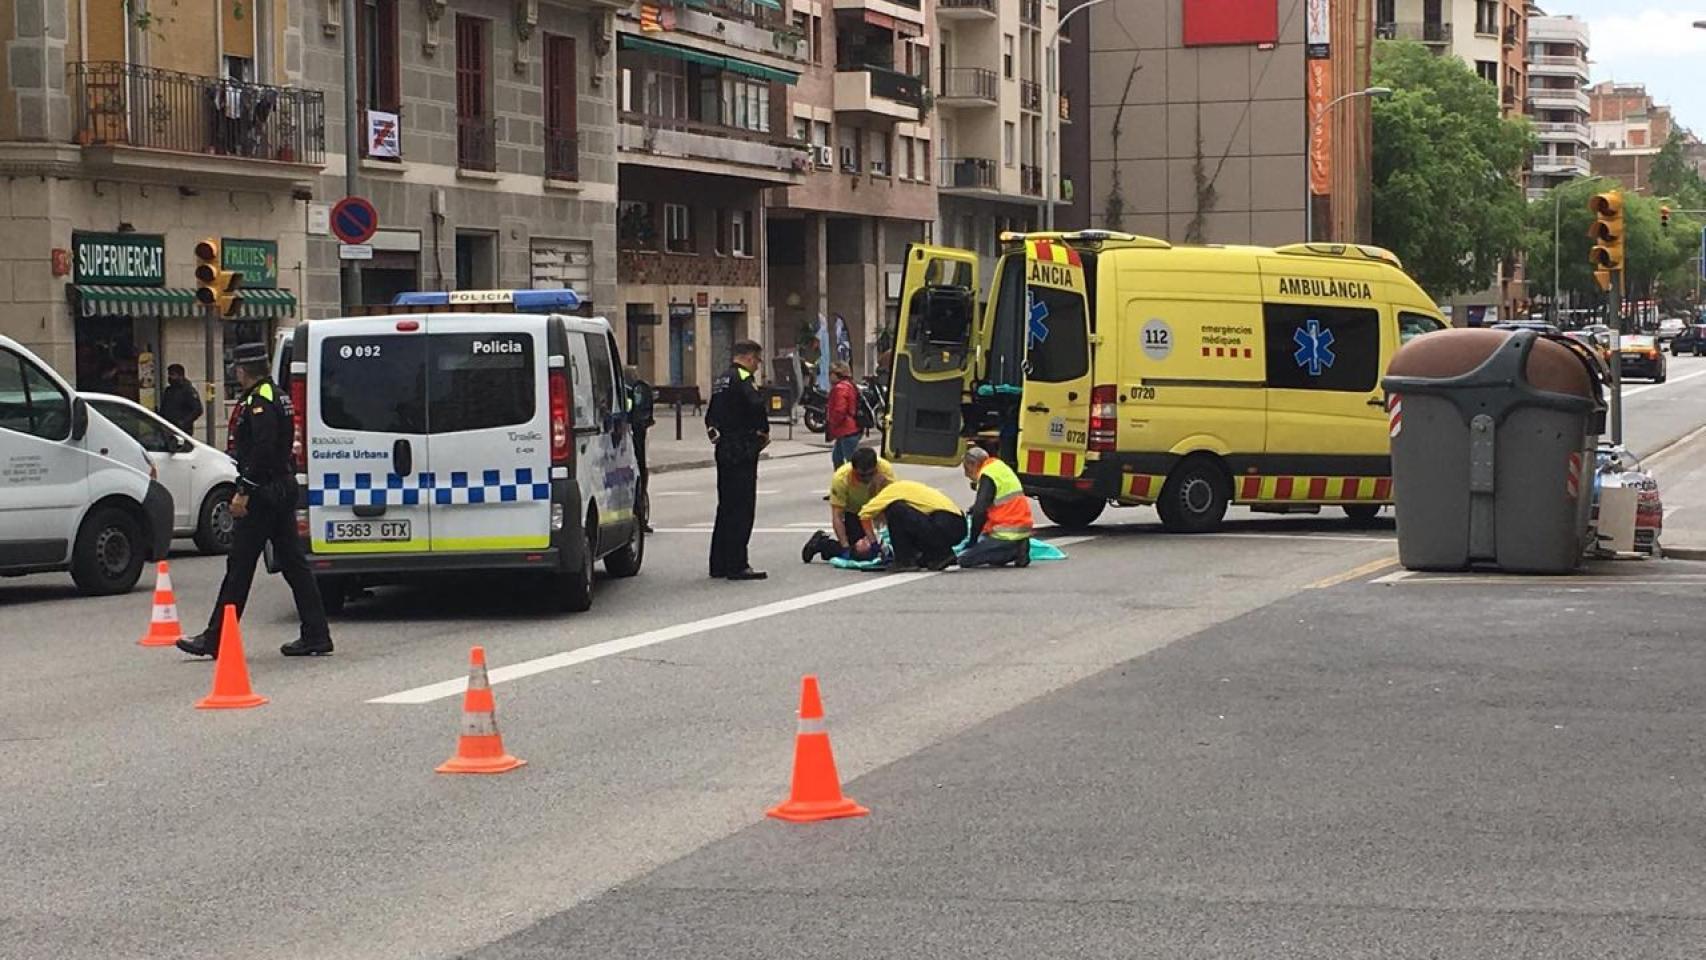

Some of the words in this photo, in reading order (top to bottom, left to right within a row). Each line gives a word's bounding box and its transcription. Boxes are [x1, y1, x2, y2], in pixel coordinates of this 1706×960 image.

[80, 243, 163, 277] SUPERMERCAT
[1280, 277, 1372, 299] AMBULÀNCIA
[452, 292, 510, 301] POLICIA
[1145, 330, 1168, 345] 112
[355, 345, 381, 357] 092
[472, 340, 522, 353] Policia
[1130, 387, 1155, 400] 0720
[1051, 423, 1063, 433] 112
[1066, 430, 1085, 444] 0720
[353, 450, 389, 459] Urbana
[336, 523, 372, 537] 5363
[381, 523, 407, 537] GTX
